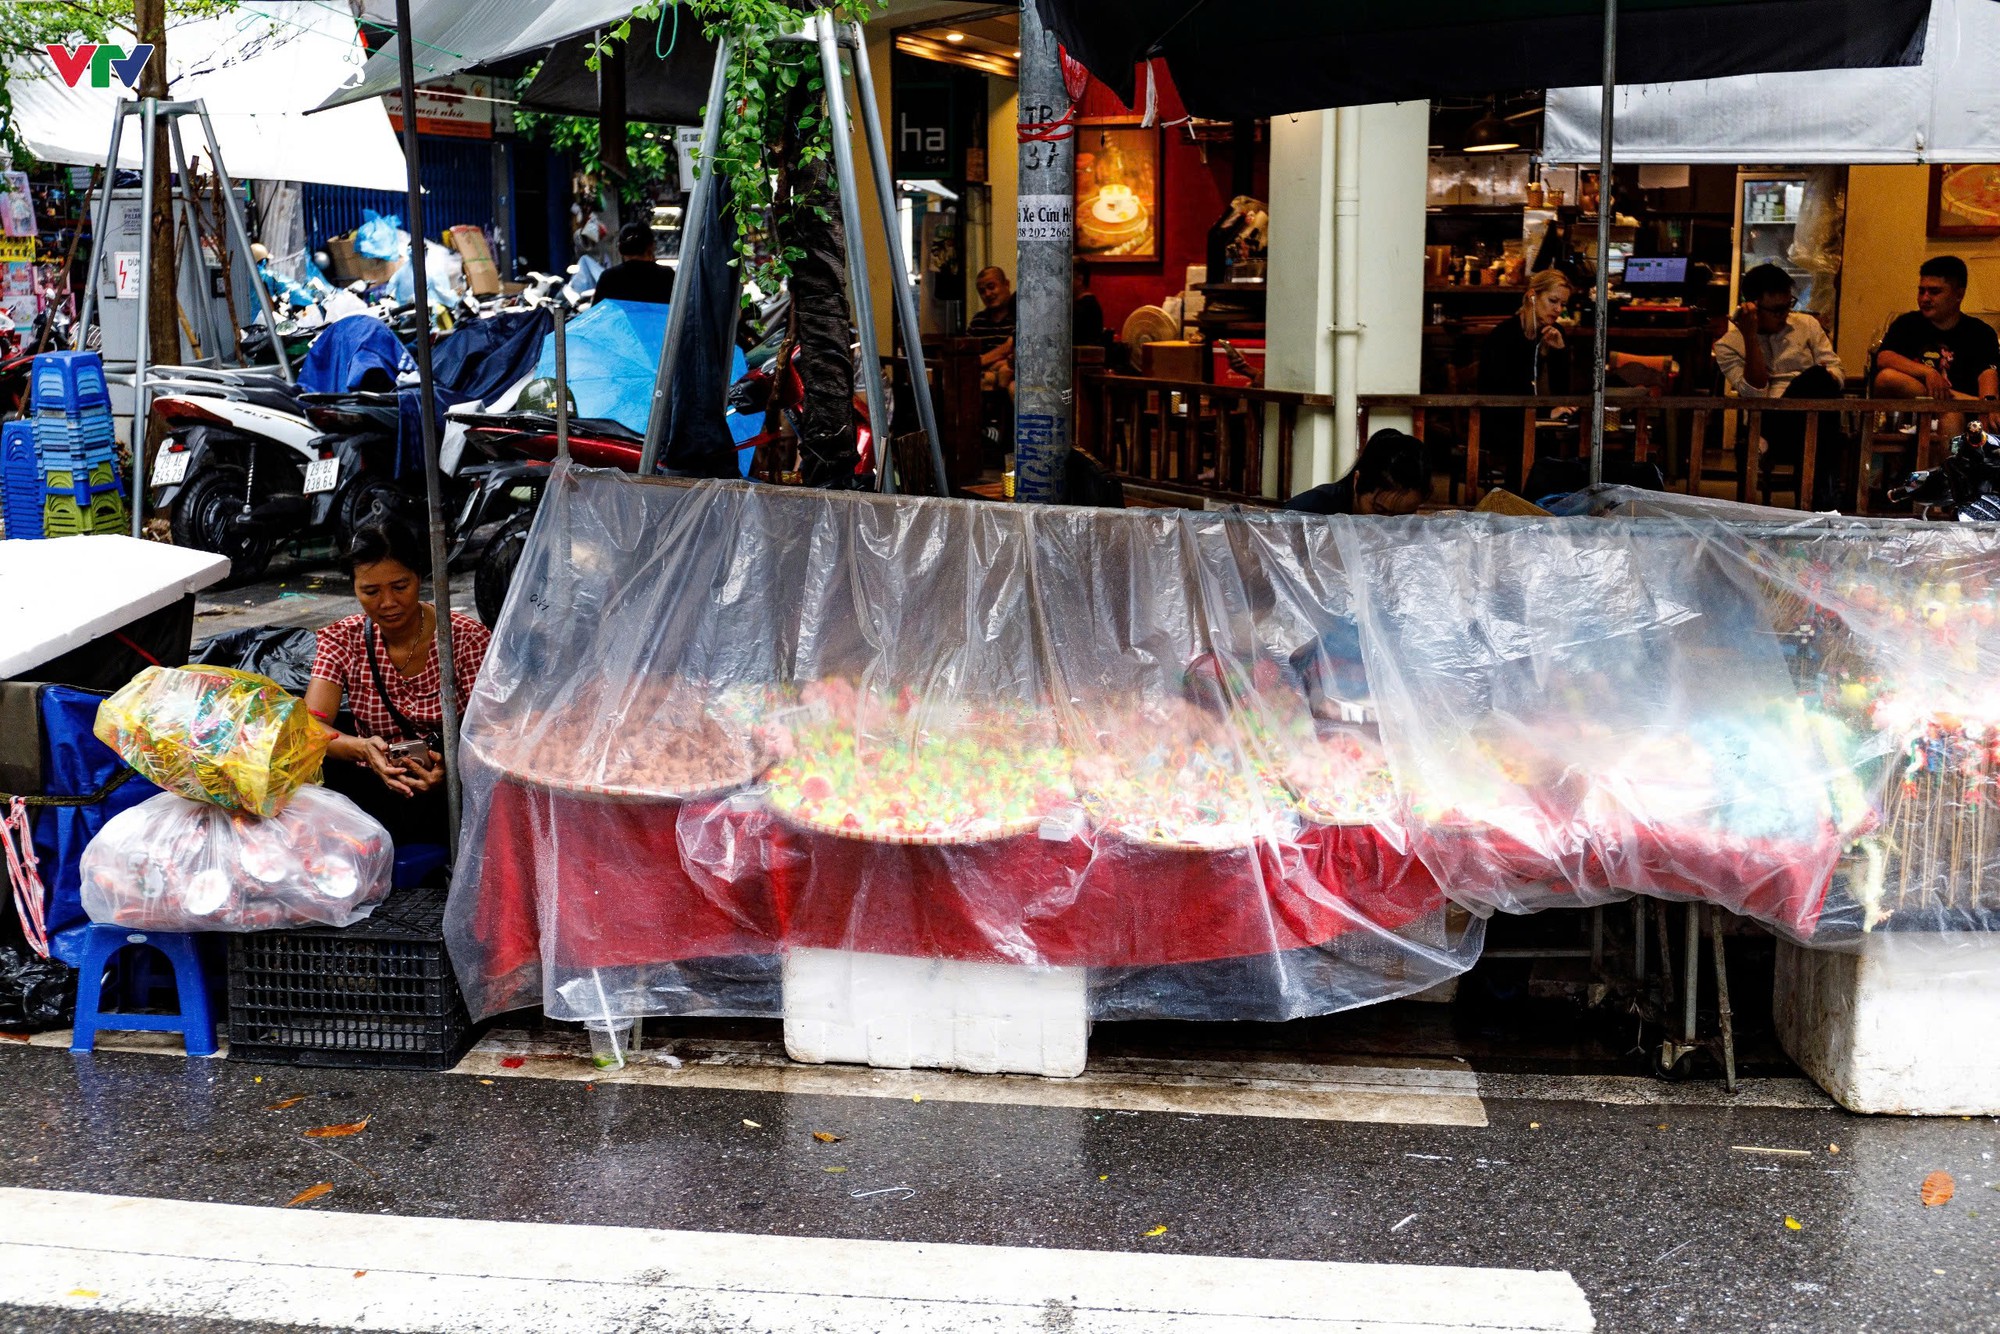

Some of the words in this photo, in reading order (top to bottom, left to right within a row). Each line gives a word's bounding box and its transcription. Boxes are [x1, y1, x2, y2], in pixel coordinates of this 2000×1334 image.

[901, 112, 945, 152] ha
[1025, 138, 1060, 171] 37
[1023, 206, 1035, 223] Xe
[1029, 228, 1047, 238] 202
[1050, 227, 1071, 238] 2662
